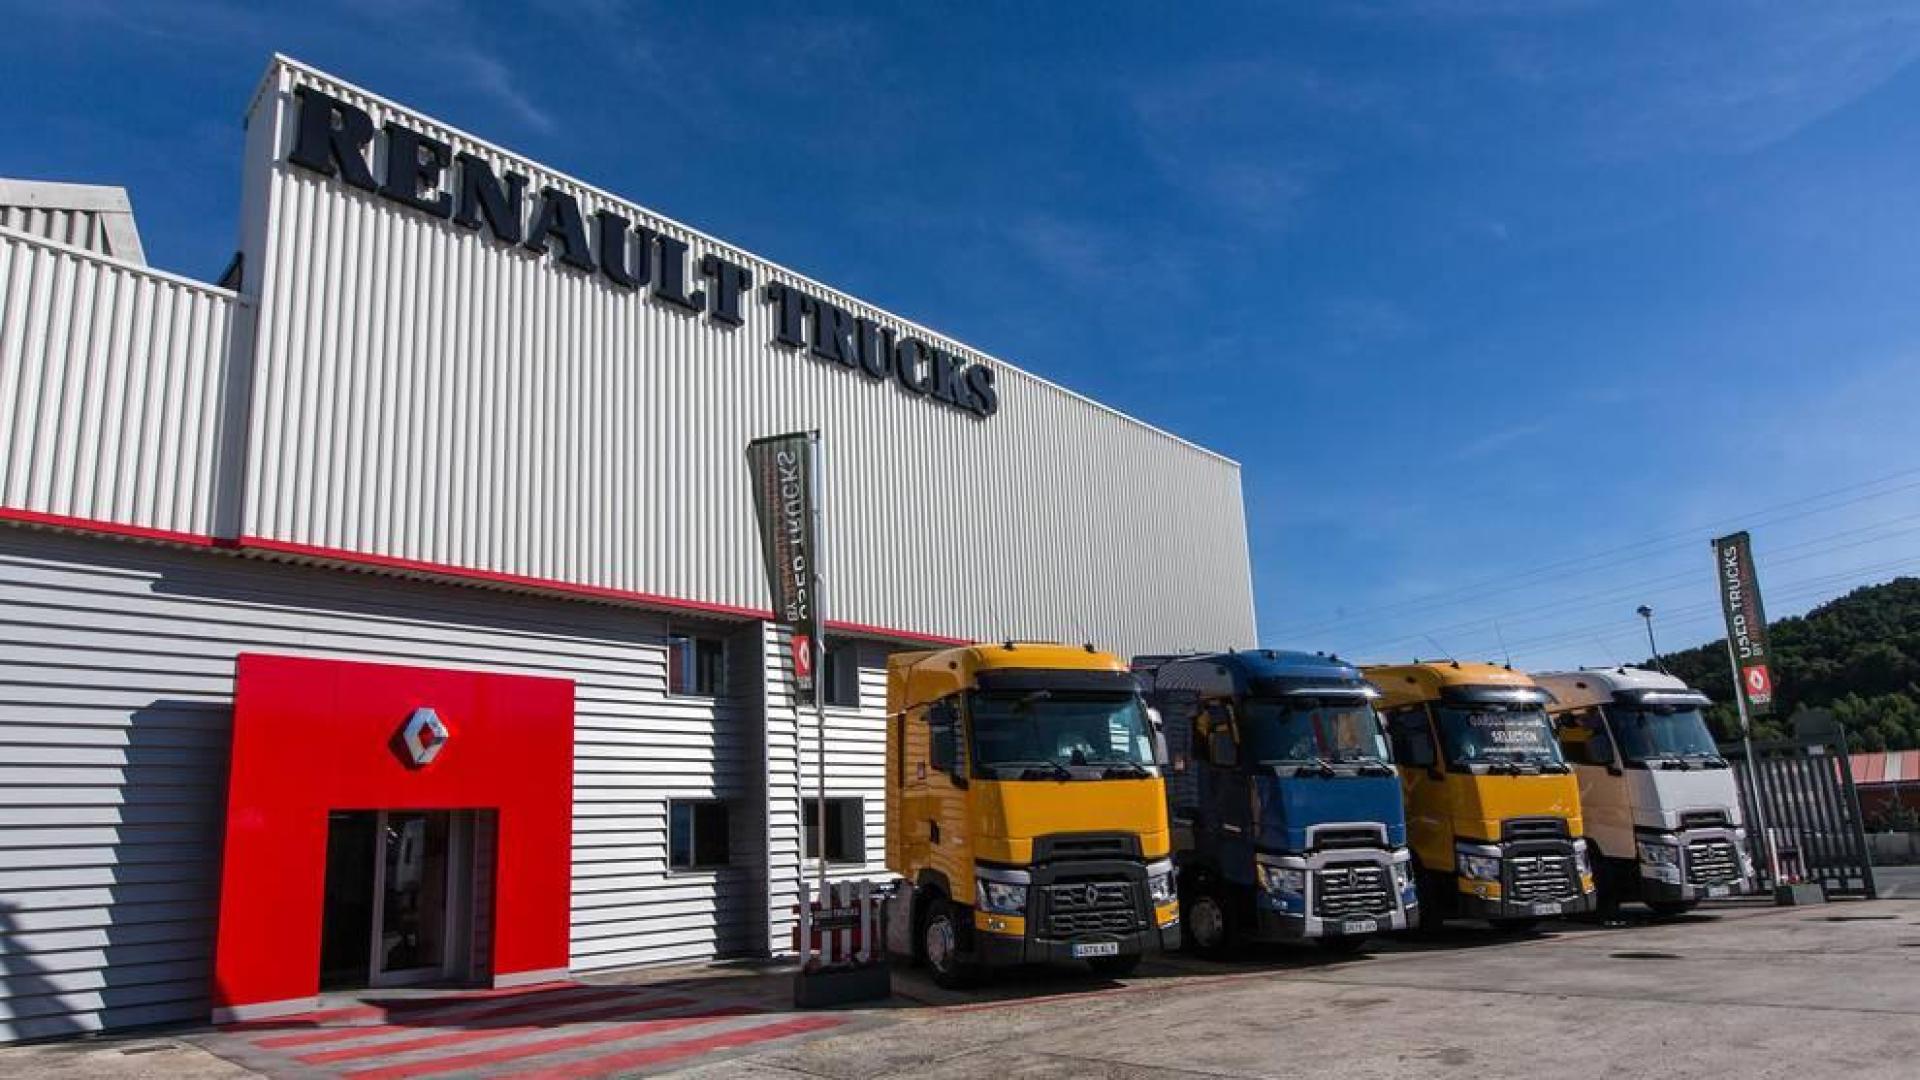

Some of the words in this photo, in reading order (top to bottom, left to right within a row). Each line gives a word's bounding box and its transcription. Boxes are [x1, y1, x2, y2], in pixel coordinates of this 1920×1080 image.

[289, 84, 751, 326] RENAULT
[764, 281, 998, 419] TRUCKS
[1724, 546, 1742, 611] TRUCKS
[1733, 614, 1751, 658] USED
